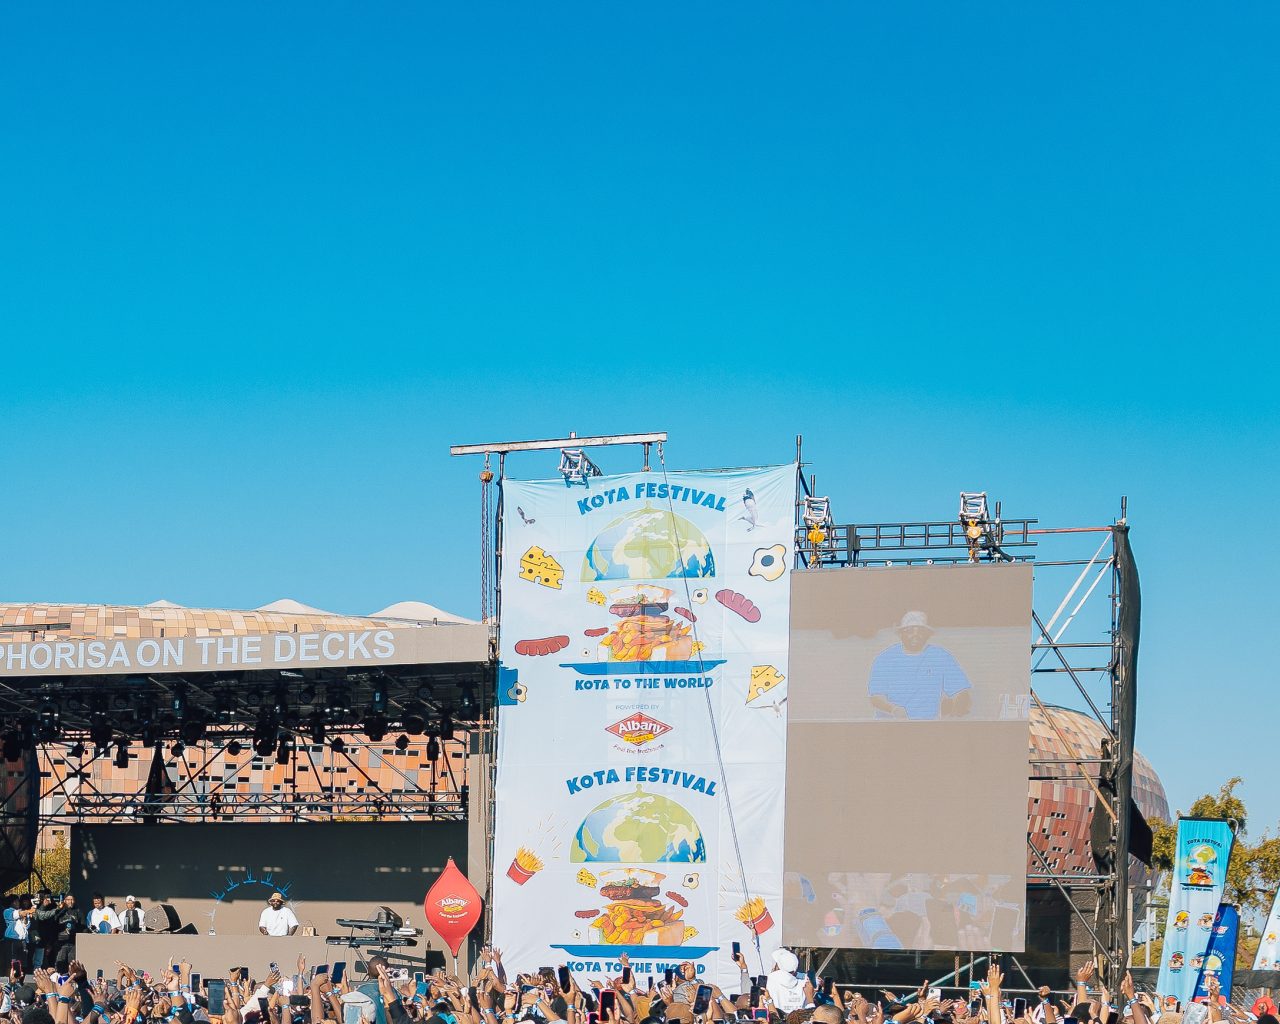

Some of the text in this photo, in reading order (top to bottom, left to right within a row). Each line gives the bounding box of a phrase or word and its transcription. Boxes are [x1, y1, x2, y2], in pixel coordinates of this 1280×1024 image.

[577, 482, 727, 515] KOTA FESTIVAL
[136, 639, 184, 667] ON
[195, 636, 262, 665] THE
[274, 630, 395, 663] DECKS
[575, 677, 714, 691] KOTA TO THE WORLD
[618, 720, 664, 735] Albany
[566, 766, 717, 797] KOTA FESTIVAL
[441, 898, 468, 907] Albany
[566, 961, 601, 972] KOTA
[605, 961, 623, 973] TO
